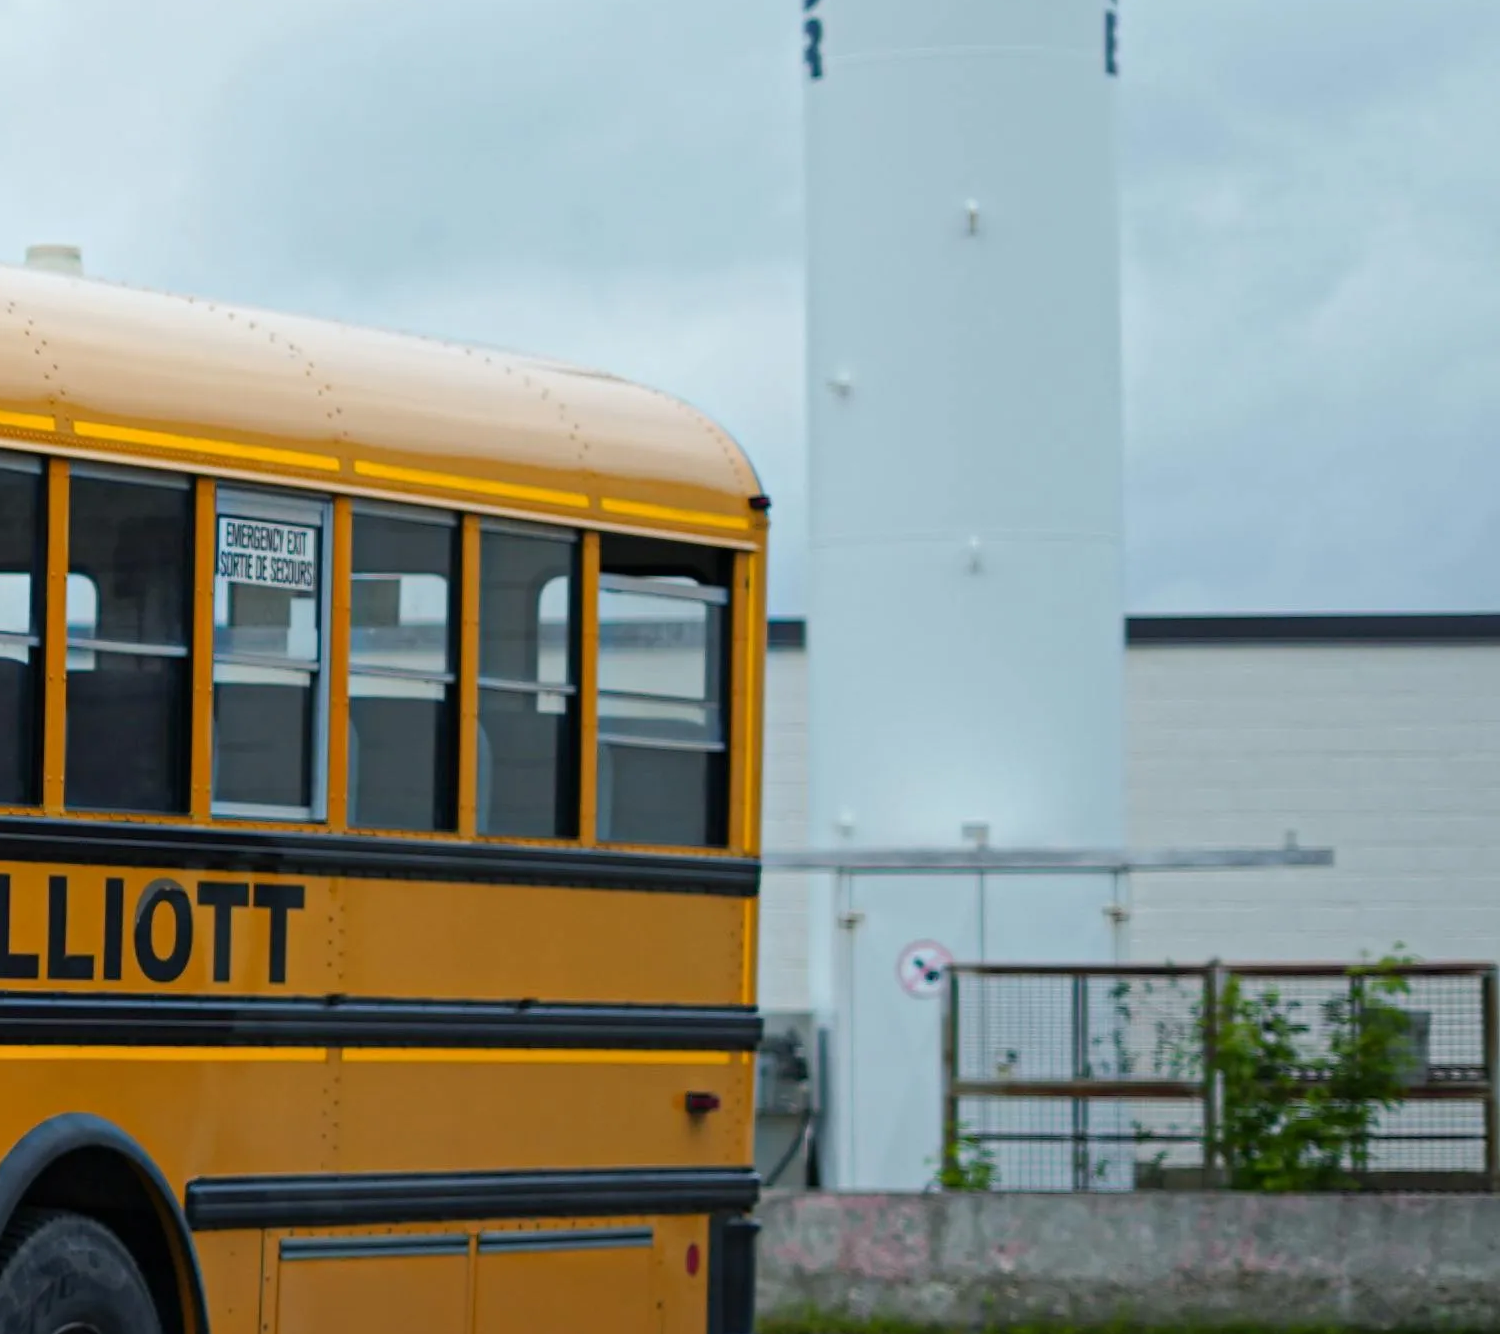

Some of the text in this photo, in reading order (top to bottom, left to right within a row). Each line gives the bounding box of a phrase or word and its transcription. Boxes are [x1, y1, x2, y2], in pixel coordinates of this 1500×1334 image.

[226, 522, 308, 556] EMERGENCY EXIT
[219, 551, 313, 587] SORTIE DE SECOURS
